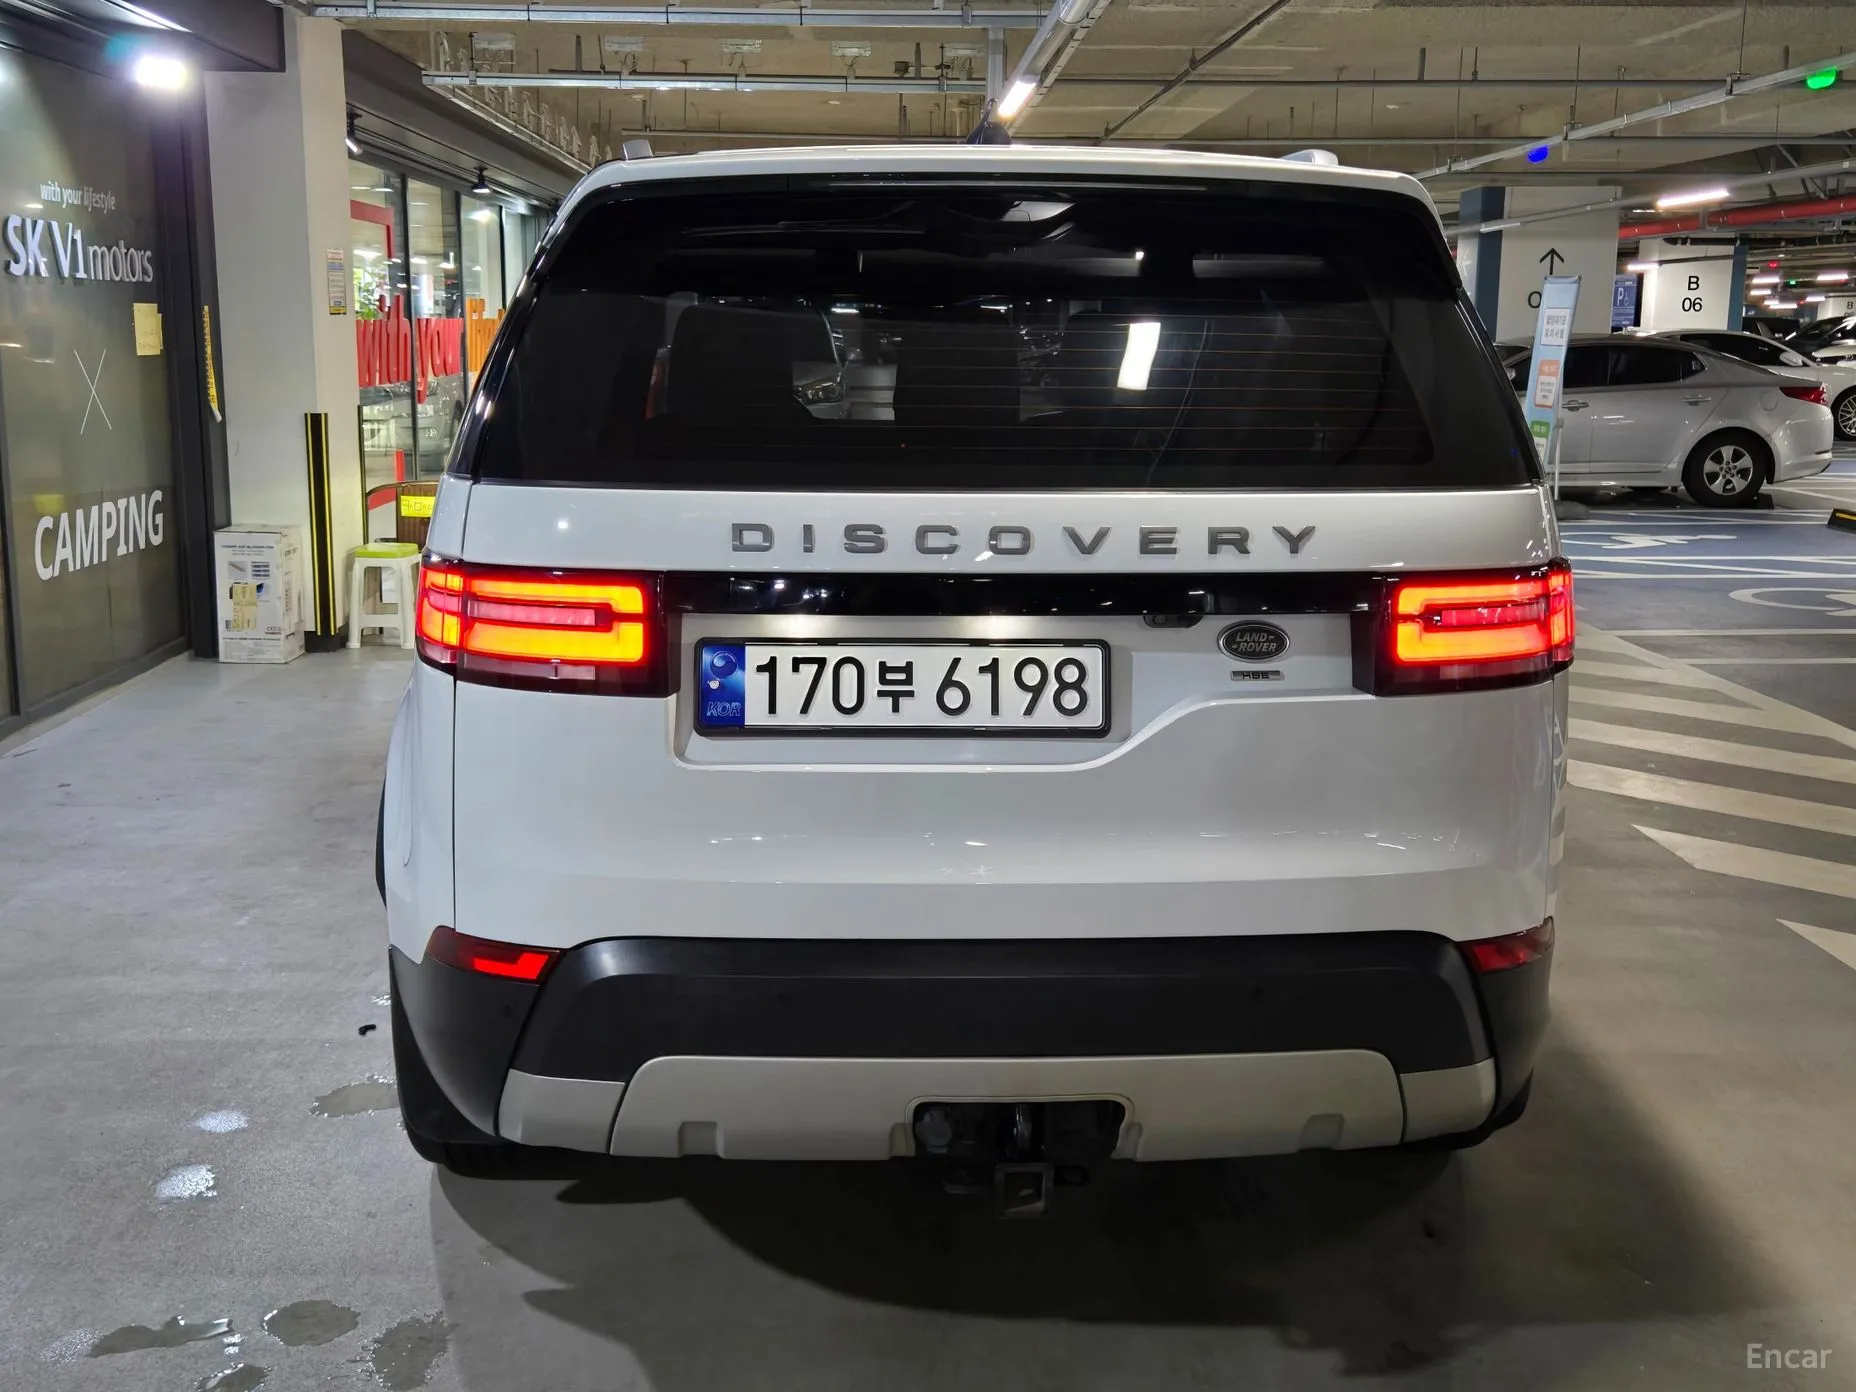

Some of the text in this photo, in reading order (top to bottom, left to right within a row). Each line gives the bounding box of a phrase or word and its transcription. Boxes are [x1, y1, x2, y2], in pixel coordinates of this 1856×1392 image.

[40, 181, 117, 214] with your lifestyle
[6, 213, 49, 278] SK
[1687, 275, 1700, 290] B
[1681, 297, 1703, 312] 06
[356, 294, 412, 388] with
[416, 317, 464, 404] your
[35, 489, 164, 580] CAMPING
[731, 523, 1316, 555] DISCOVERY
[756, 655, 1088, 717] 170부 6198
[1242, 671, 1271, 680] HSE
[706, 701, 741, 717] KOR
